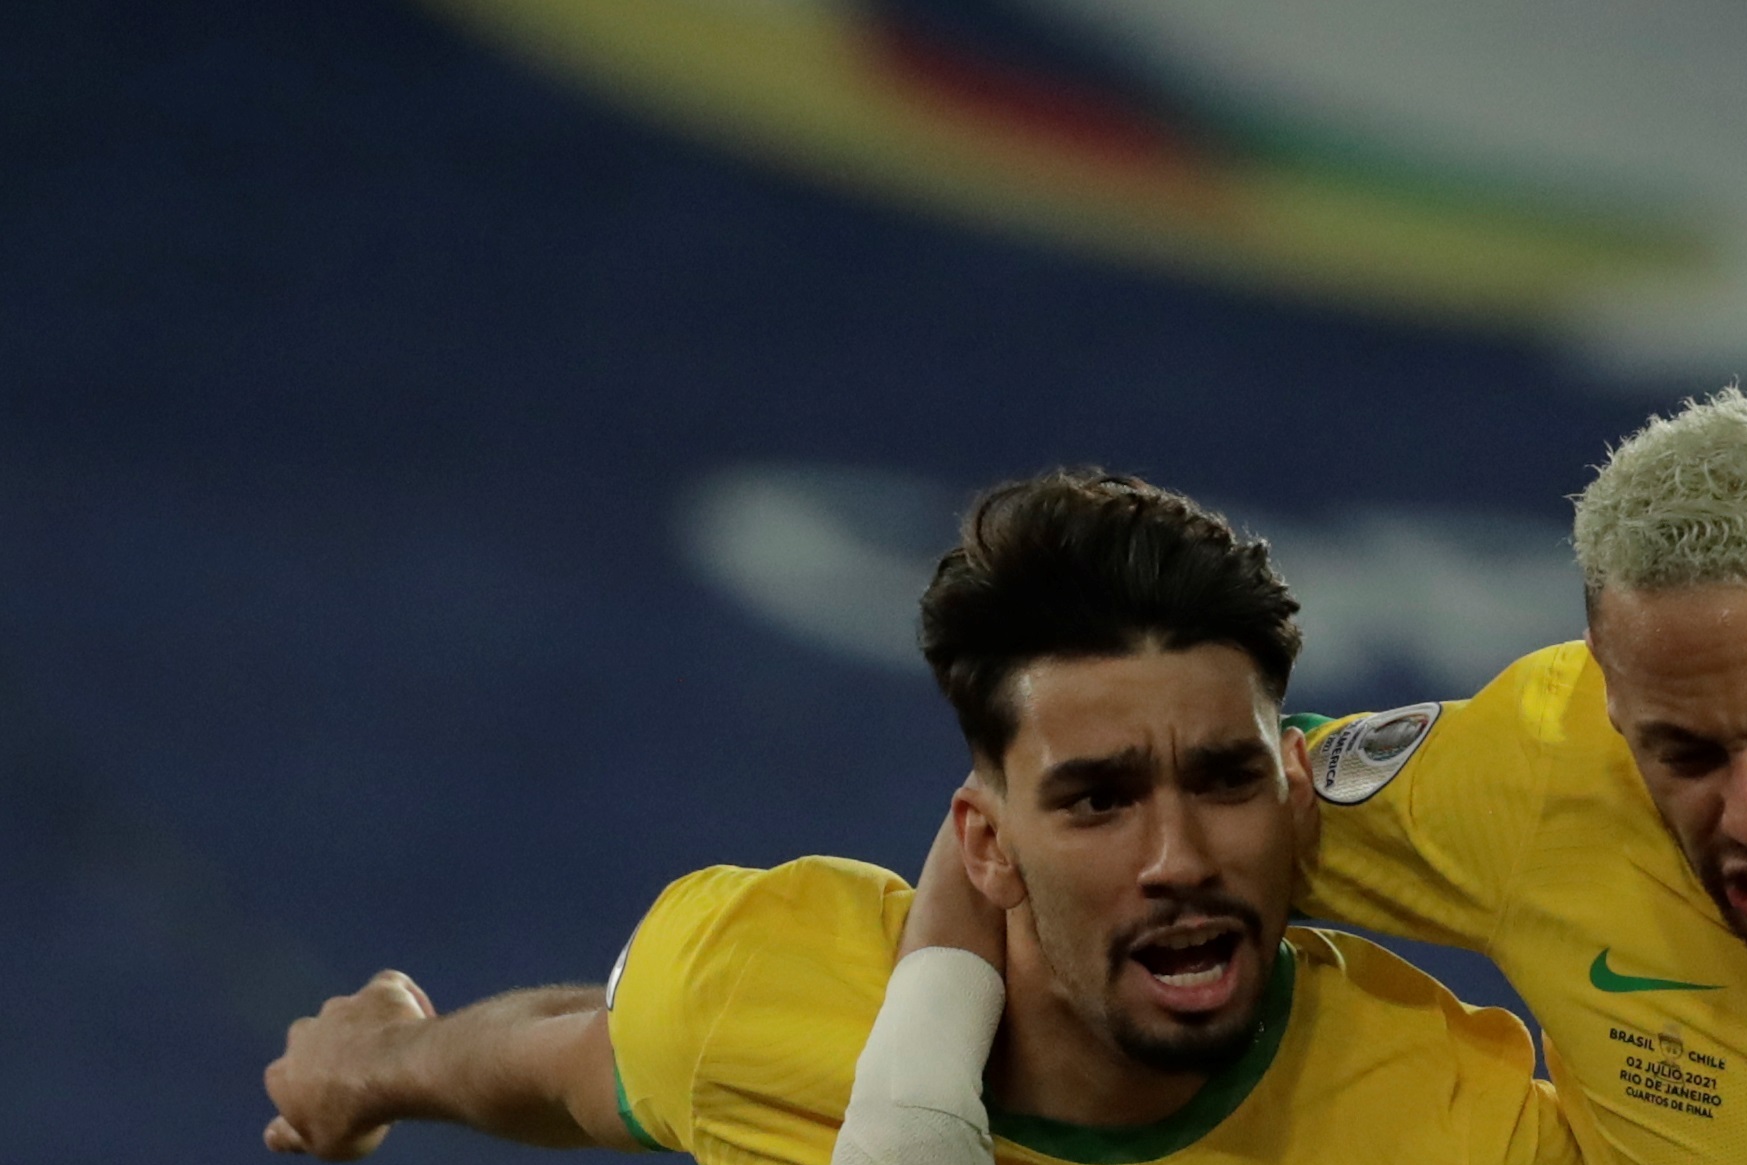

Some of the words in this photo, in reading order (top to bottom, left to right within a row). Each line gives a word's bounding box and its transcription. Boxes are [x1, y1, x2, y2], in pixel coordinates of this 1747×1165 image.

[1609, 1028, 1655, 1052] BRASIL
[1688, 1051, 1726, 1070] CHILE
[1620, 1069, 1642, 1085] RIO
[1645, 1078, 1662, 1092] DE
[1664, 1083, 1722, 1107] JANEIRO
[1626, 1056, 1643, 1070] 02
[1645, 1062, 1683, 1081] JULIO
[1685, 1072, 1717, 1090] 2021
[1626, 1086, 1669, 1108] CUARTOS
[1671, 1100, 1684, 1112] DE
[1686, 1104, 1714, 1119] FINAL
